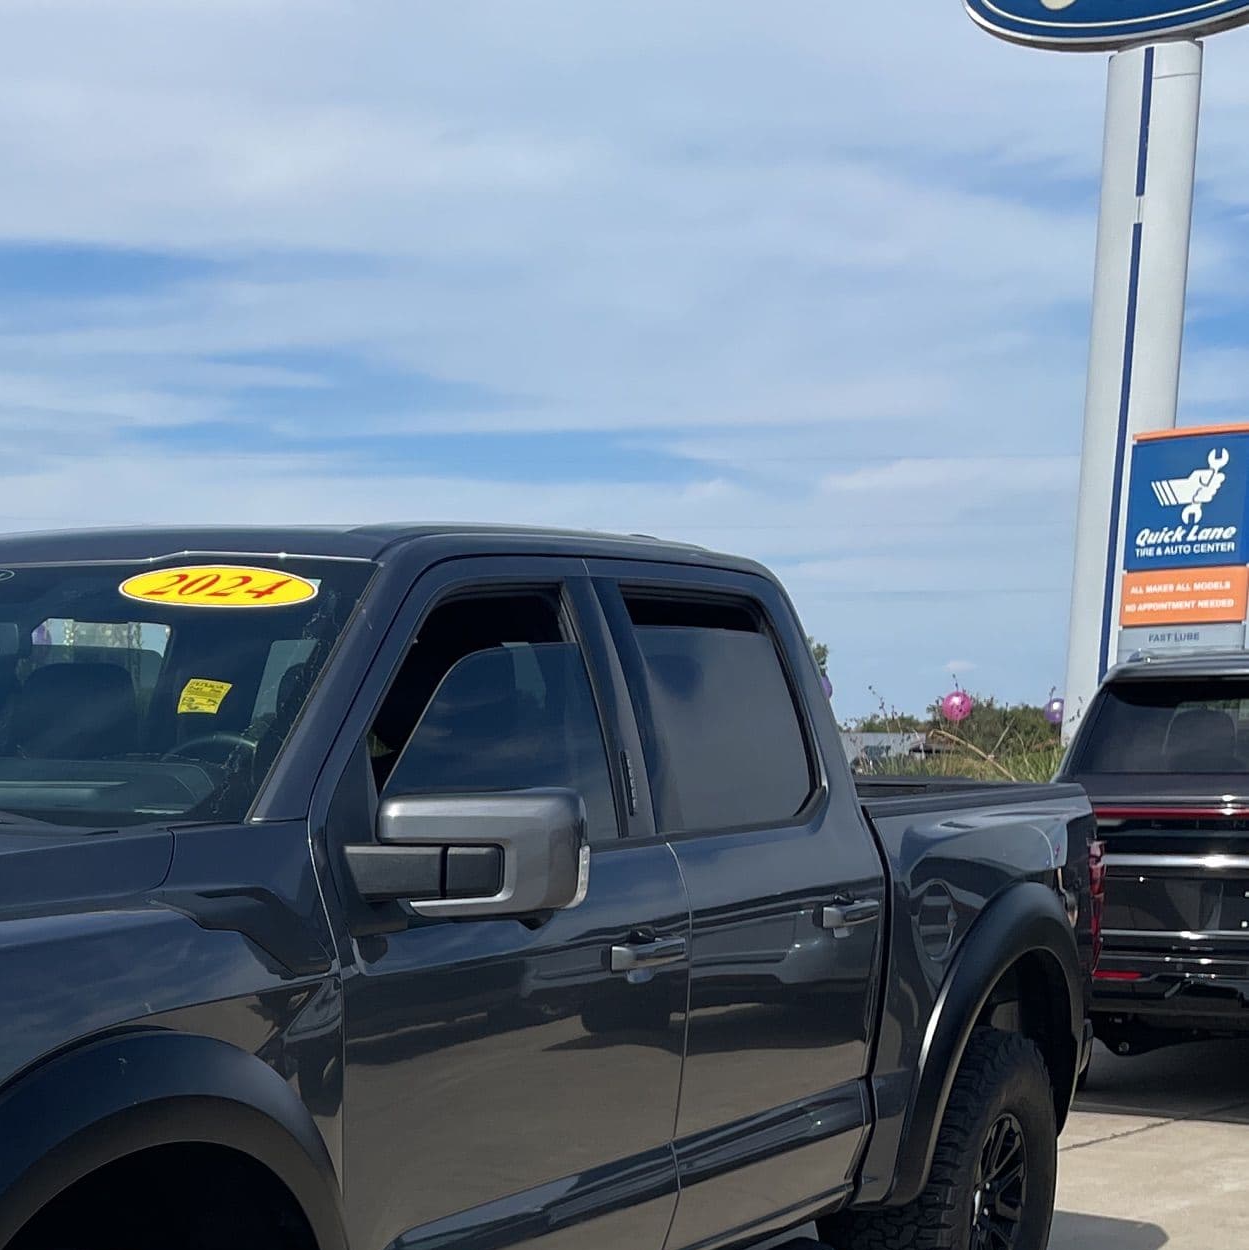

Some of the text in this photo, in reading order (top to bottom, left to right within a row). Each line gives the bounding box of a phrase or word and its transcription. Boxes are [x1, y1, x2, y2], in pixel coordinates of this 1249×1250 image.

[1135, 525, 1237, 547] Quick Lane
[1135, 541, 1235, 558] TIRE & AUTO CENTER
[142, 574, 293, 599] 2024
[1130, 580, 1231, 595] ALL MAKES ALL MODELS
[1125, 598, 1235, 612] NO APPOINTMENT NEEDED
[1148, 631, 1200, 643] FAST LUBE
